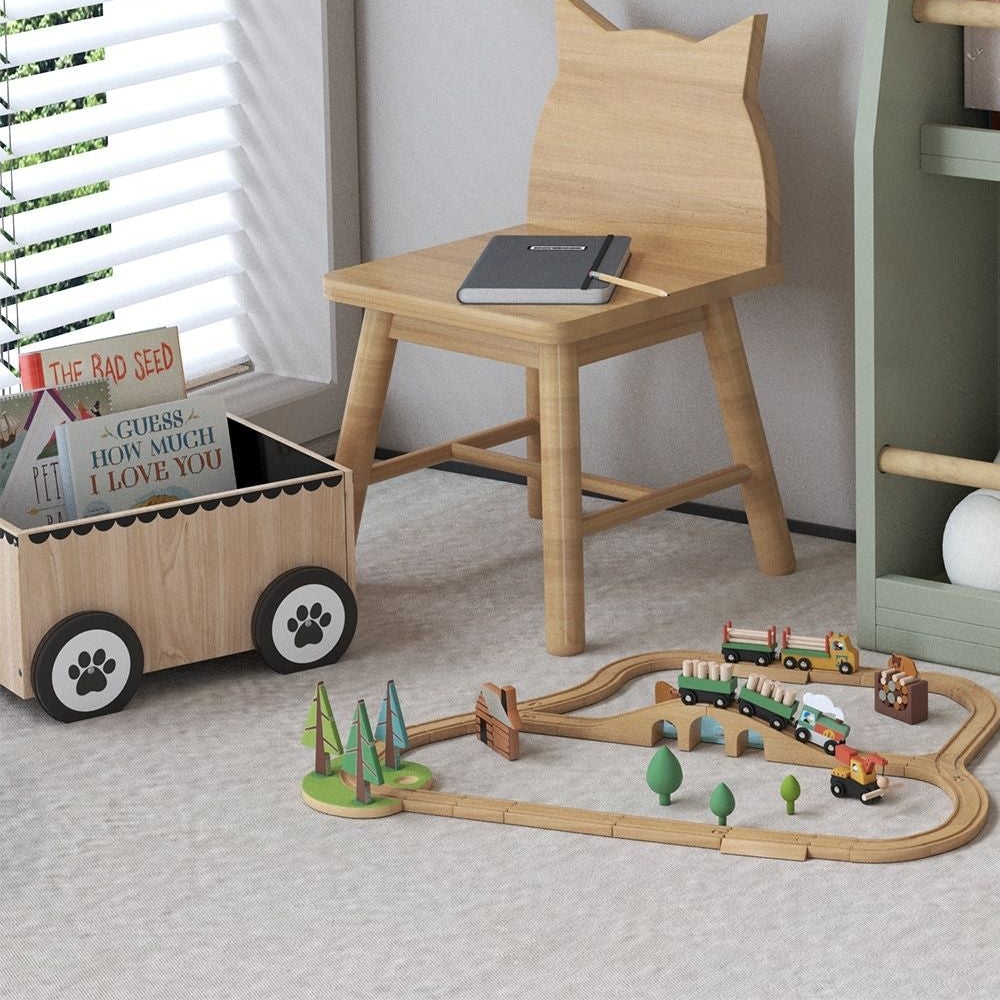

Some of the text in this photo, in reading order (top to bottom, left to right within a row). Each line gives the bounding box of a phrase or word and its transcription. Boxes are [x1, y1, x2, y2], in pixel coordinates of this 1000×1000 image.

[133, 342, 174, 381] SEED
[116, 409, 184, 440] GUESS
[91, 426, 215, 470] HOW MUCH
[89, 448, 223, 496] I LOVE YOU
